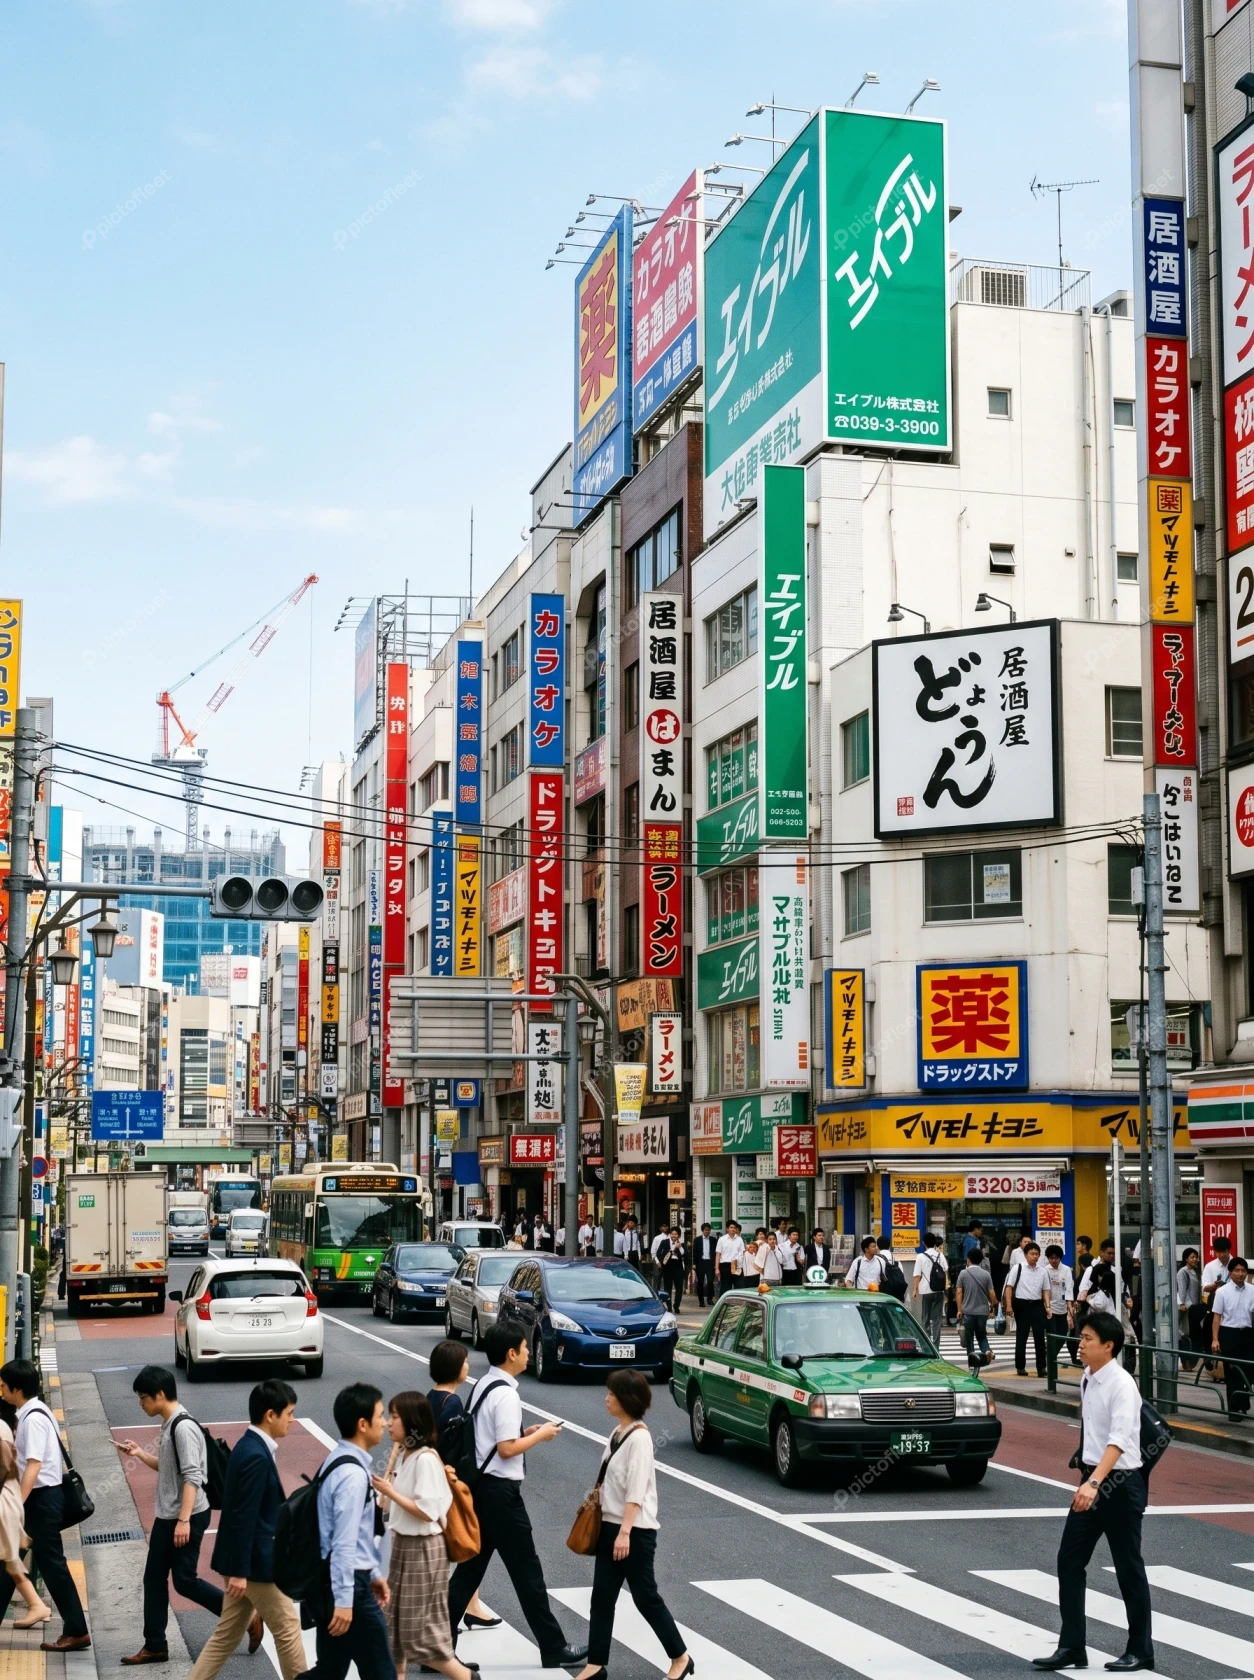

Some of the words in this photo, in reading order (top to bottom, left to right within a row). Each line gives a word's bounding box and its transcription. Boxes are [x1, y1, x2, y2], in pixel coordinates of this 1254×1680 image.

[835, 153, 937, 331] エイブル
[1148, 210, 1181, 325] 居酒屋
[708, 148, 811, 413] エイブル
[850, 415, 939, 435] 039-3-3900
[1154, 345, 1181, 469] カラオケ
[1159, 489, 1180, 510] 薬
[765, 573, 804, 690] エイブル
[533, 609, 560, 749] カラオケ
[998, 646, 1030, 747] 居酒屋
[650, 865, 677, 969] ラーメン
[718, 939, 757, 1000] エイブル
[839, 974, 858, 1080] マツモトキヨシ
[930, 973, 1010, 1054] 薬
[658, 1020, 675, 1082] ラーメン
[922, 1062, 1018, 1083] ドラッグストア
[723, 1101, 753, 1147] エイブル
[821, 1116, 867, 1147] マツモトキヨシ
[896, 1111, 1044, 1145] マツモトキヨシ
[893, 1203, 915, 1225] 薬
[978, 1177, 1012, 1194] 320
[1038, 1204, 1062, 1226] 薬
